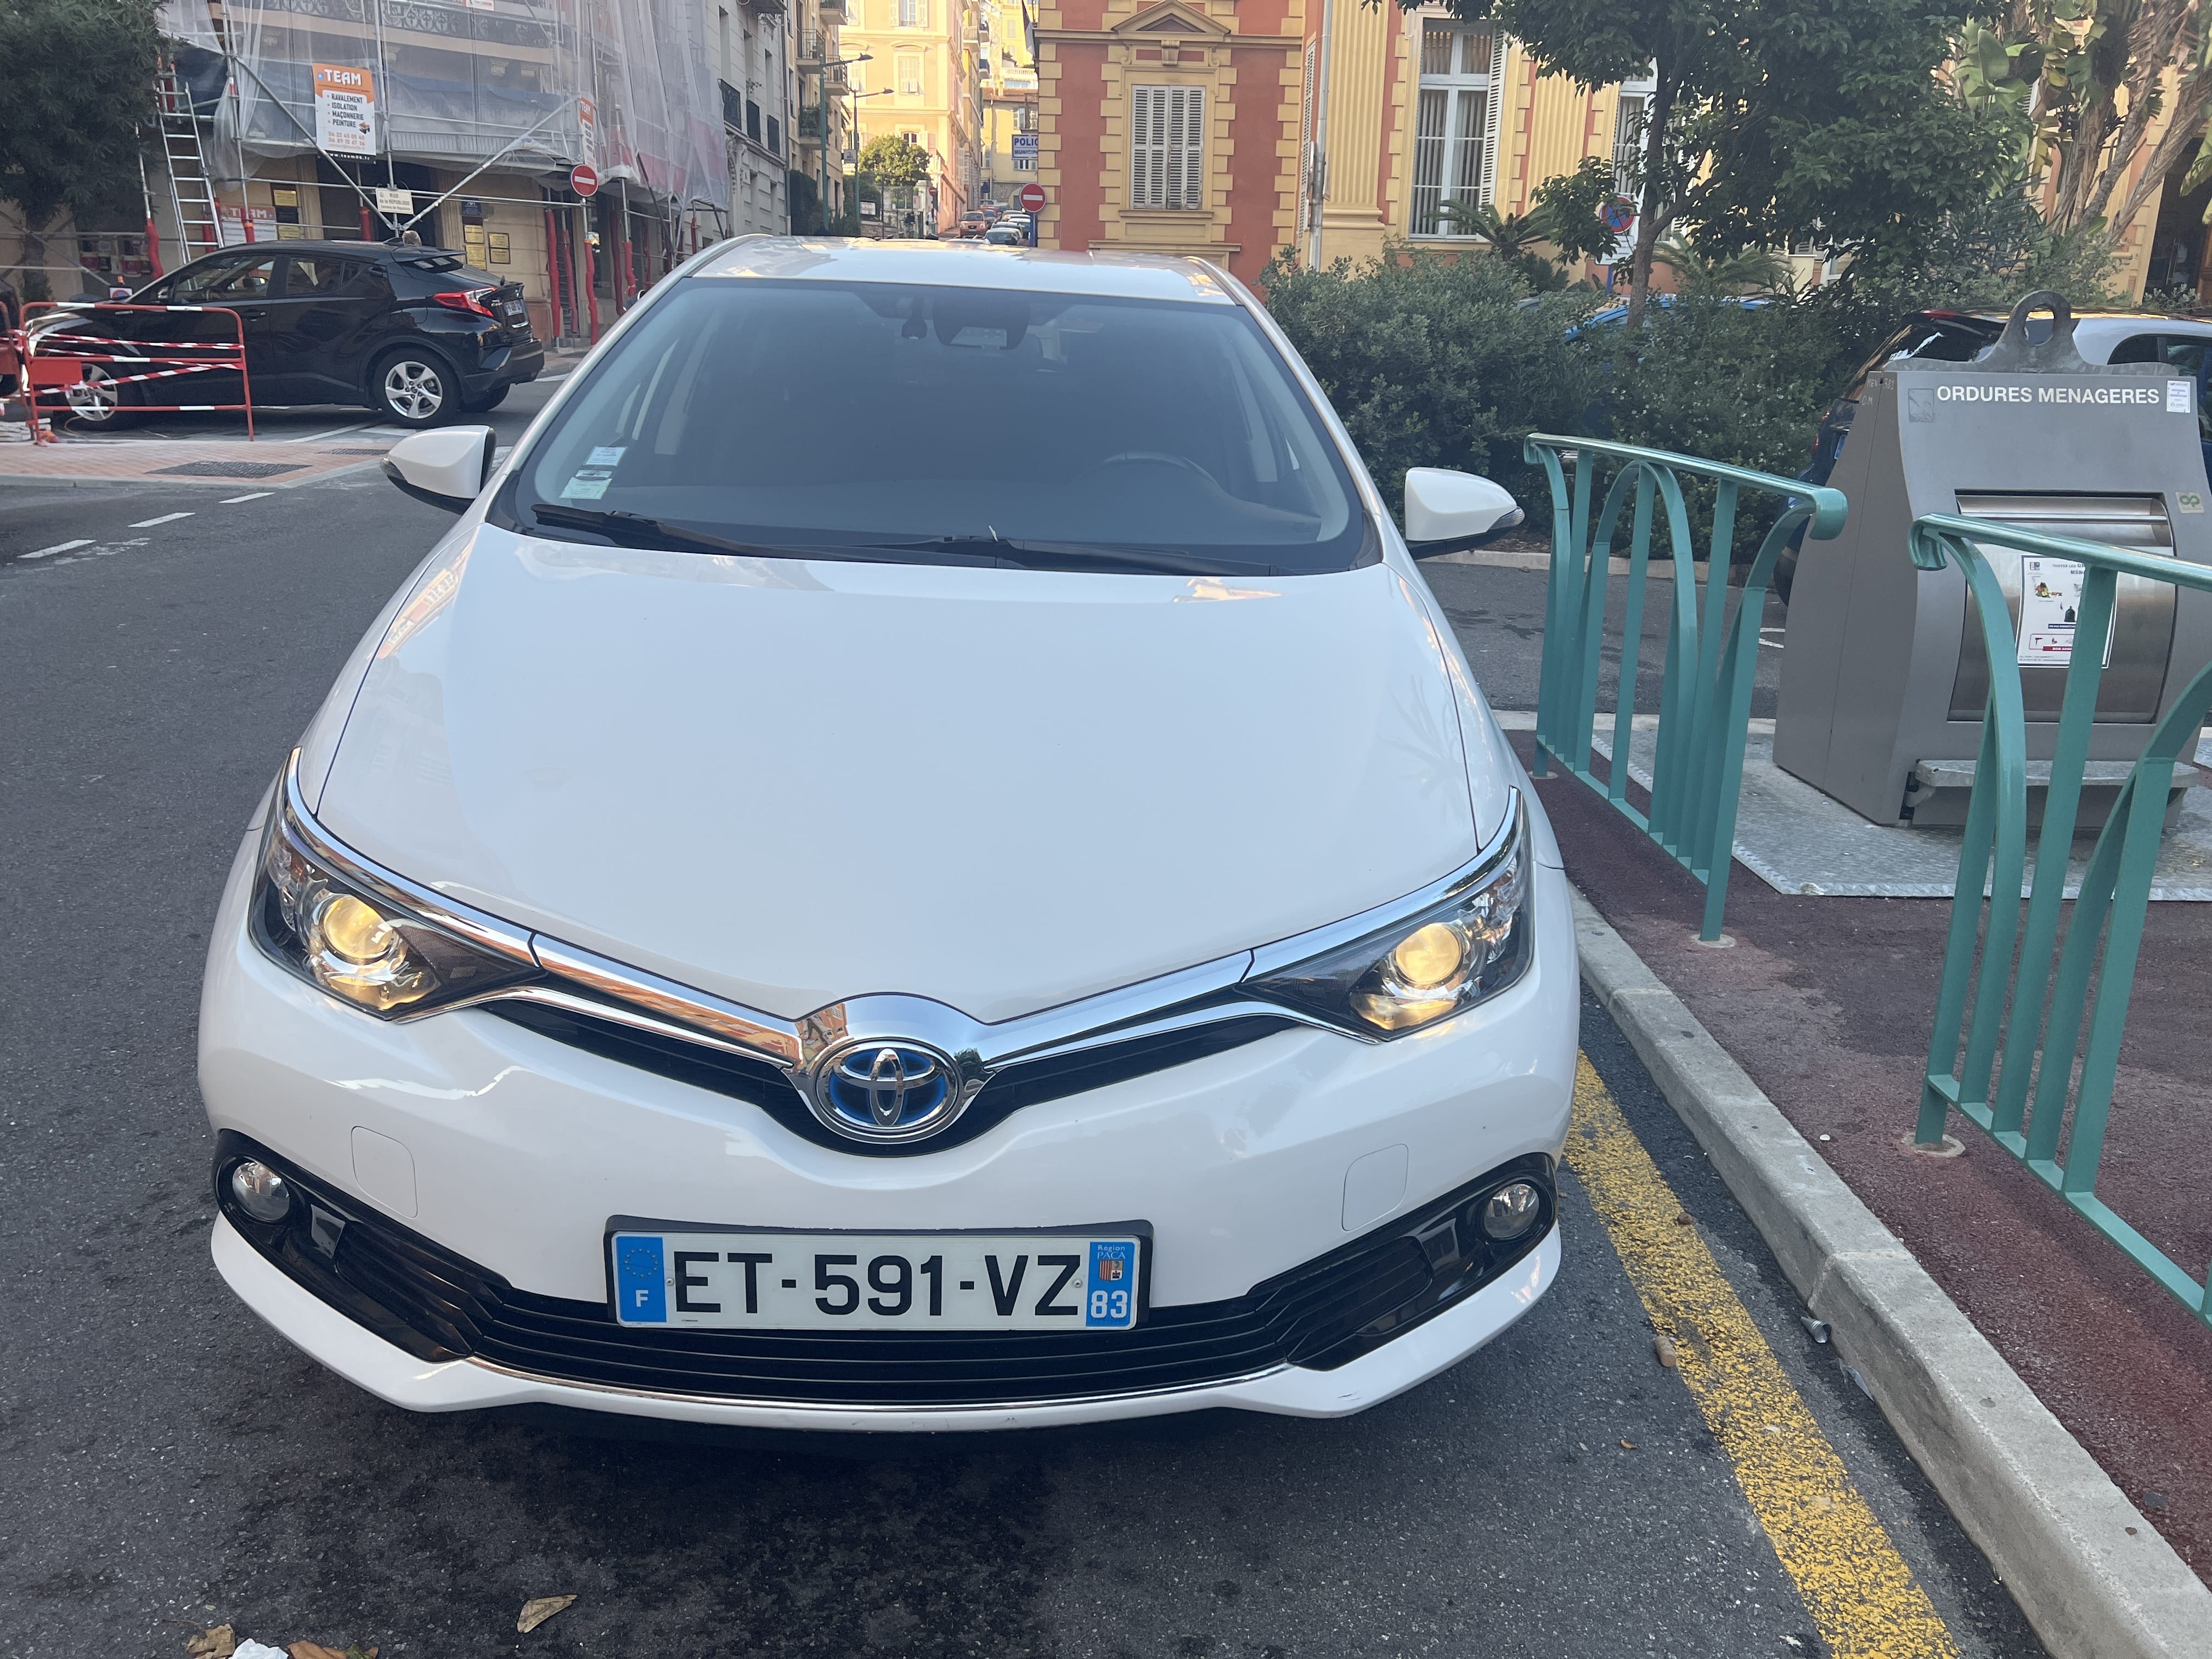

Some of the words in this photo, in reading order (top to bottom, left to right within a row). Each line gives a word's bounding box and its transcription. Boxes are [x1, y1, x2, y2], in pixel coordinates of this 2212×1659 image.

[324, 69, 362, 86] TEAM
[331, 93, 363, 104] RAVALEMENT
[332, 102, 358, 111] ISOLATION
[332, 111, 364, 121] MAÇONNERIE
[332, 119, 357, 128] PEINTURE
[1937, 386, 2033, 402] ORDURES
[2038, 388, 2160, 404] MENAGERES
[1098, 1244, 1125, 1253] Région
[674, 1251, 1081, 1316] ET-591-VZ
[635, 1290, 648, 1307] F
[1091, 1290, 1128, 1318] 83
